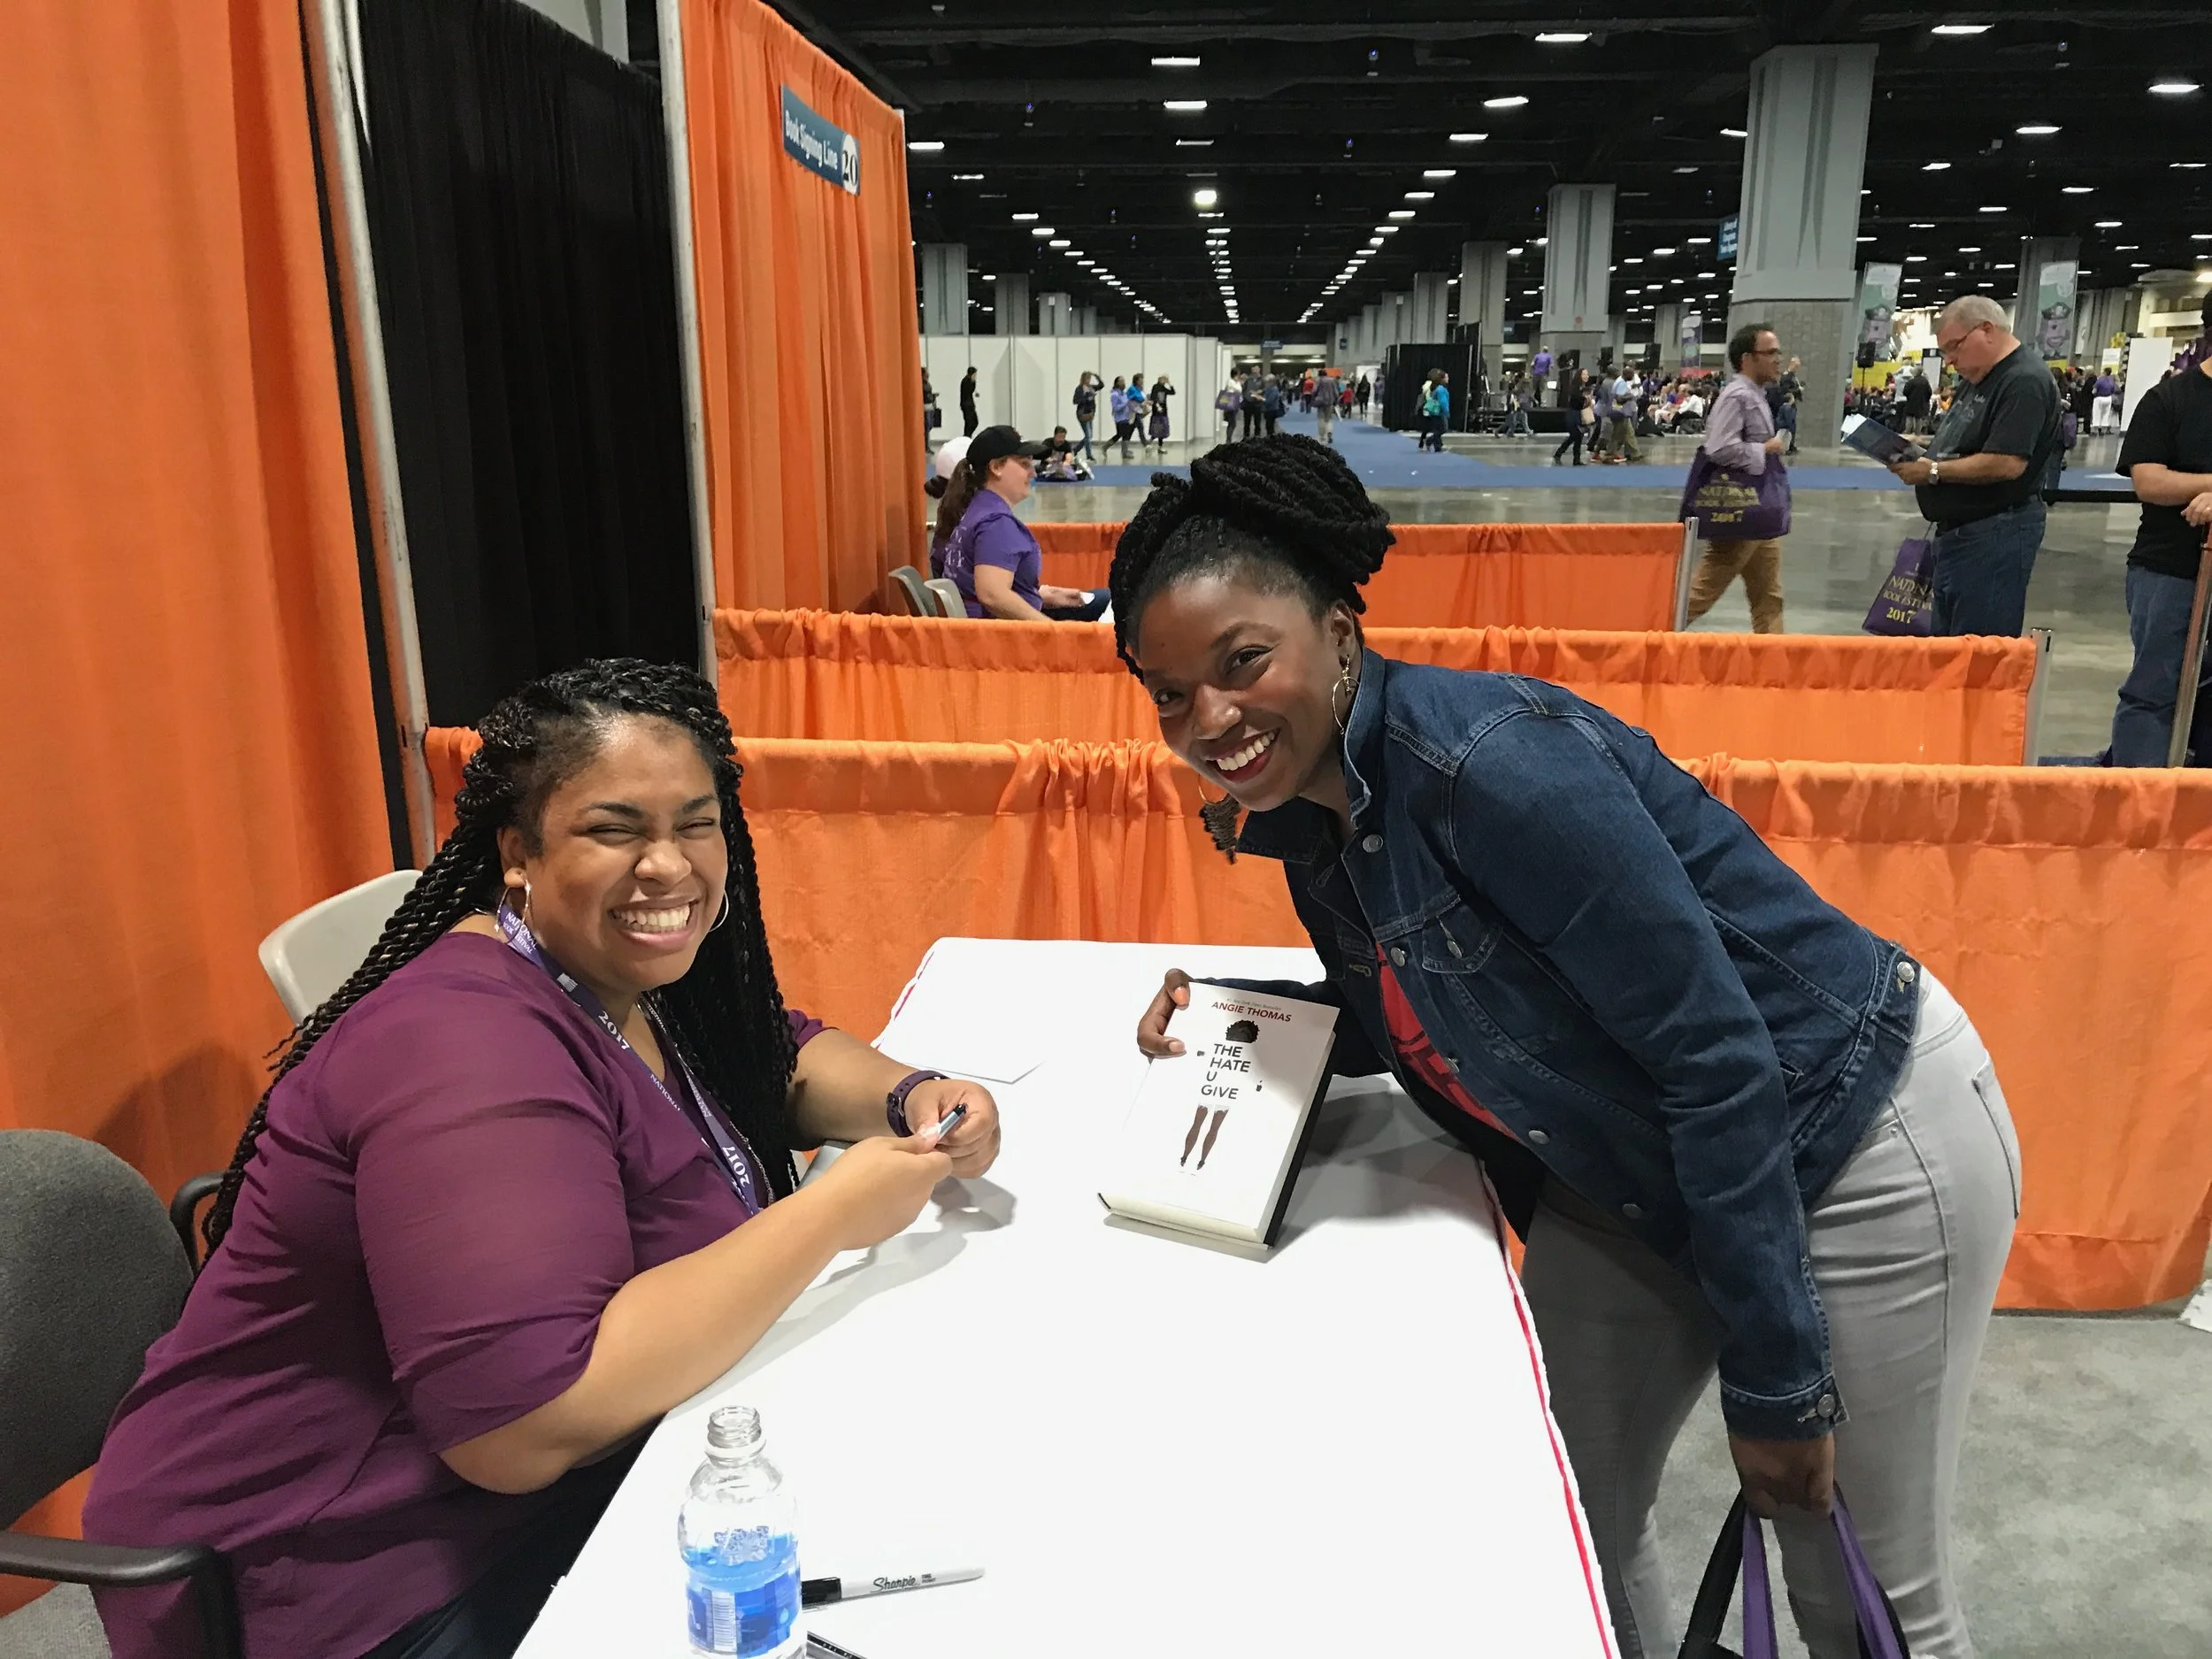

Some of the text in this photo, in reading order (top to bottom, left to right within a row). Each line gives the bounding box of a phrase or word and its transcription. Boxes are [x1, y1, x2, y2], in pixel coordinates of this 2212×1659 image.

[842, 150, 857, 186] 20
[1888, 575, 1935, 599] NATIONA
[1886, 606, 1917, 624] 2017
[514, 932, 533, 955] ESTIVAL
[1211, 1001, 1245, 1013] ANGIE
[1247, 1007, 1292, 1022] THOMAS
[598, 1010, 630, 1050] 2017
[1214, 1043, 1243, 1058] THE
[1210, 1056, 1251, 1073] HATE
[1206, 1071, 1217, 1082] U
[1201, 1084, 1240, 1100] GIVE
[722, 1146, 750, 1187] 2017
[872, 1575, 917, 1592] Sharpie
